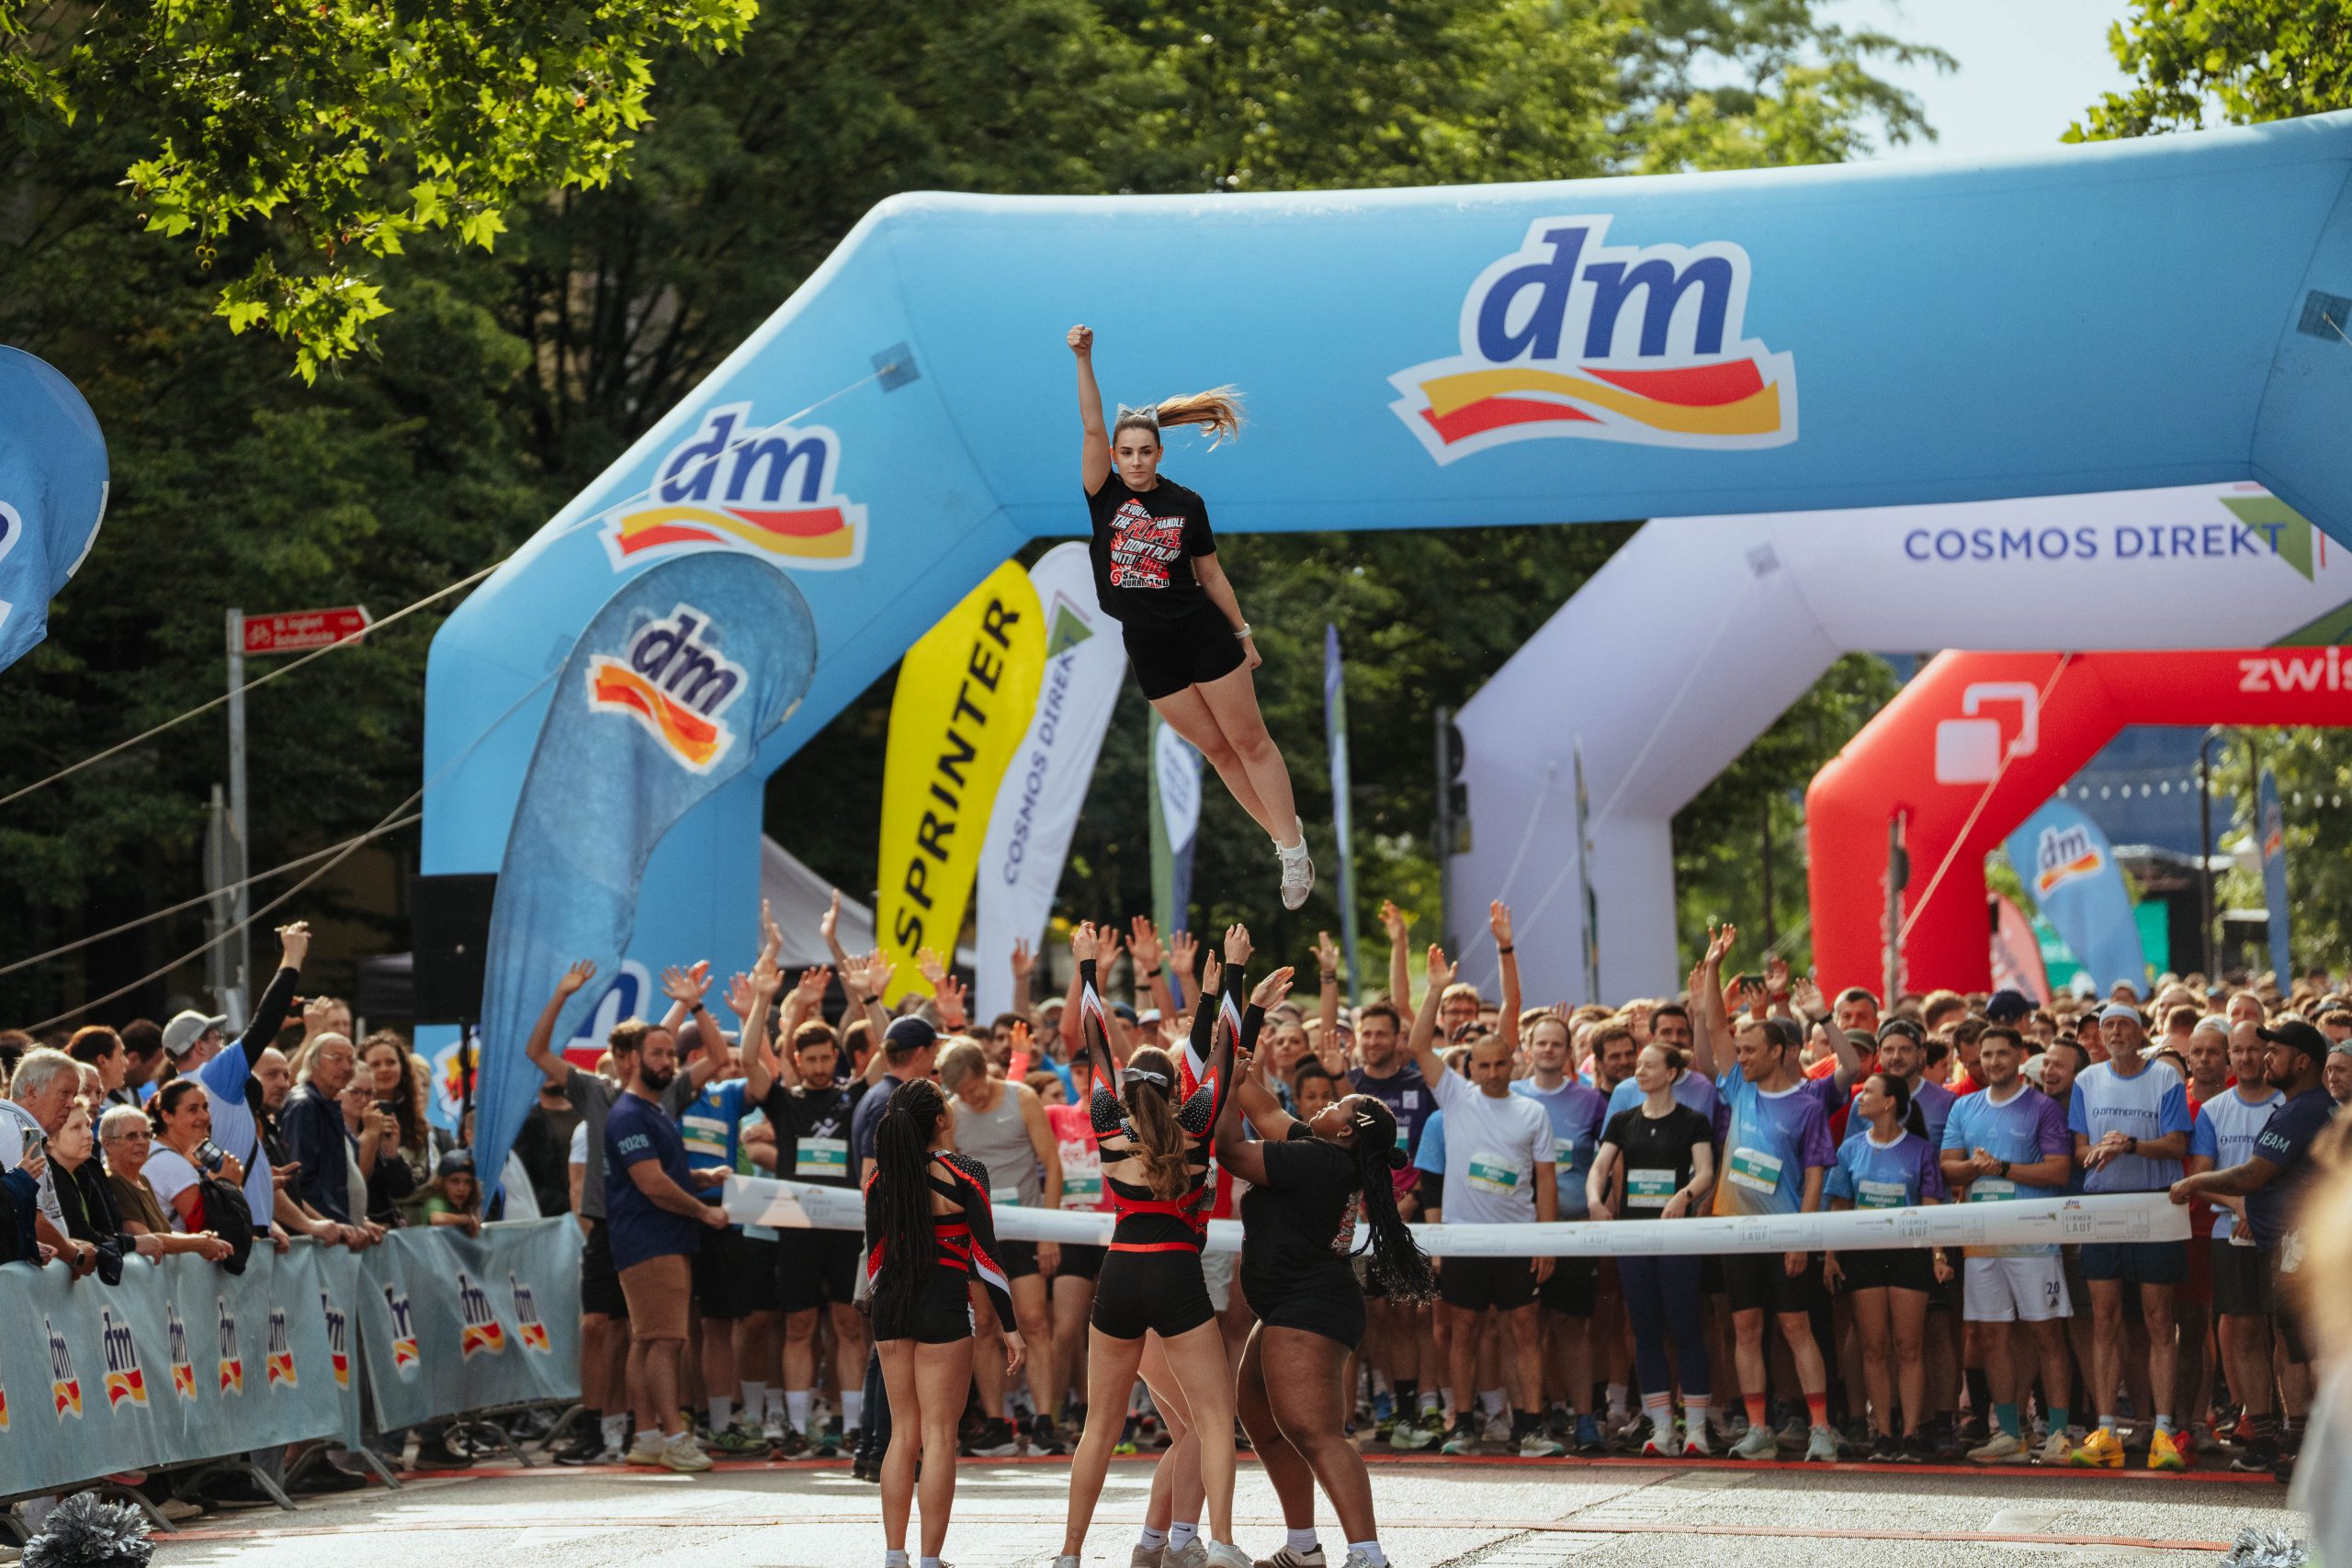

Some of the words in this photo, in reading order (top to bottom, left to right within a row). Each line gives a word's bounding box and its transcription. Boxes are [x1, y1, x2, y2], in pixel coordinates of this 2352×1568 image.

[1476, 226, 1734, 364] dm
[660, 412, 828, 503] dm
[1111, 513, 1135, 530] THE
[1119, 502, 1130, 513] IF
[1128, 504, 1145, 516] YOU
[1156, 517, 1184, 530] HANDLE
[1111, 550, 1136, 565] WITH
[1131, 556, 1166, 574] FIRE
[1121, 537, 1157, 557] DON'T
[1150, 547, 1182, 562] PLAY
[1905, 526, 2098, 562] COSMOS
[2114, 522, 2288, 559] DIREKT
[630, 613, 739, 716] dm
[895, 597, 1021, 958] SPRINTER
[1003, 751, 1048, 886] COSMOS
[1037, 631, 1077, 747] DIREKT
[2041, 829, 2087, 870] dm
[2064, 1198, 2080, 1207] dm
[1902, 1227, 1928, 1238] LAUF
[2065, 1222, 2093, 1234] LAUF
[458, 1274, 492, 1325] dm
[103, 1311, 137, 1372] dm
